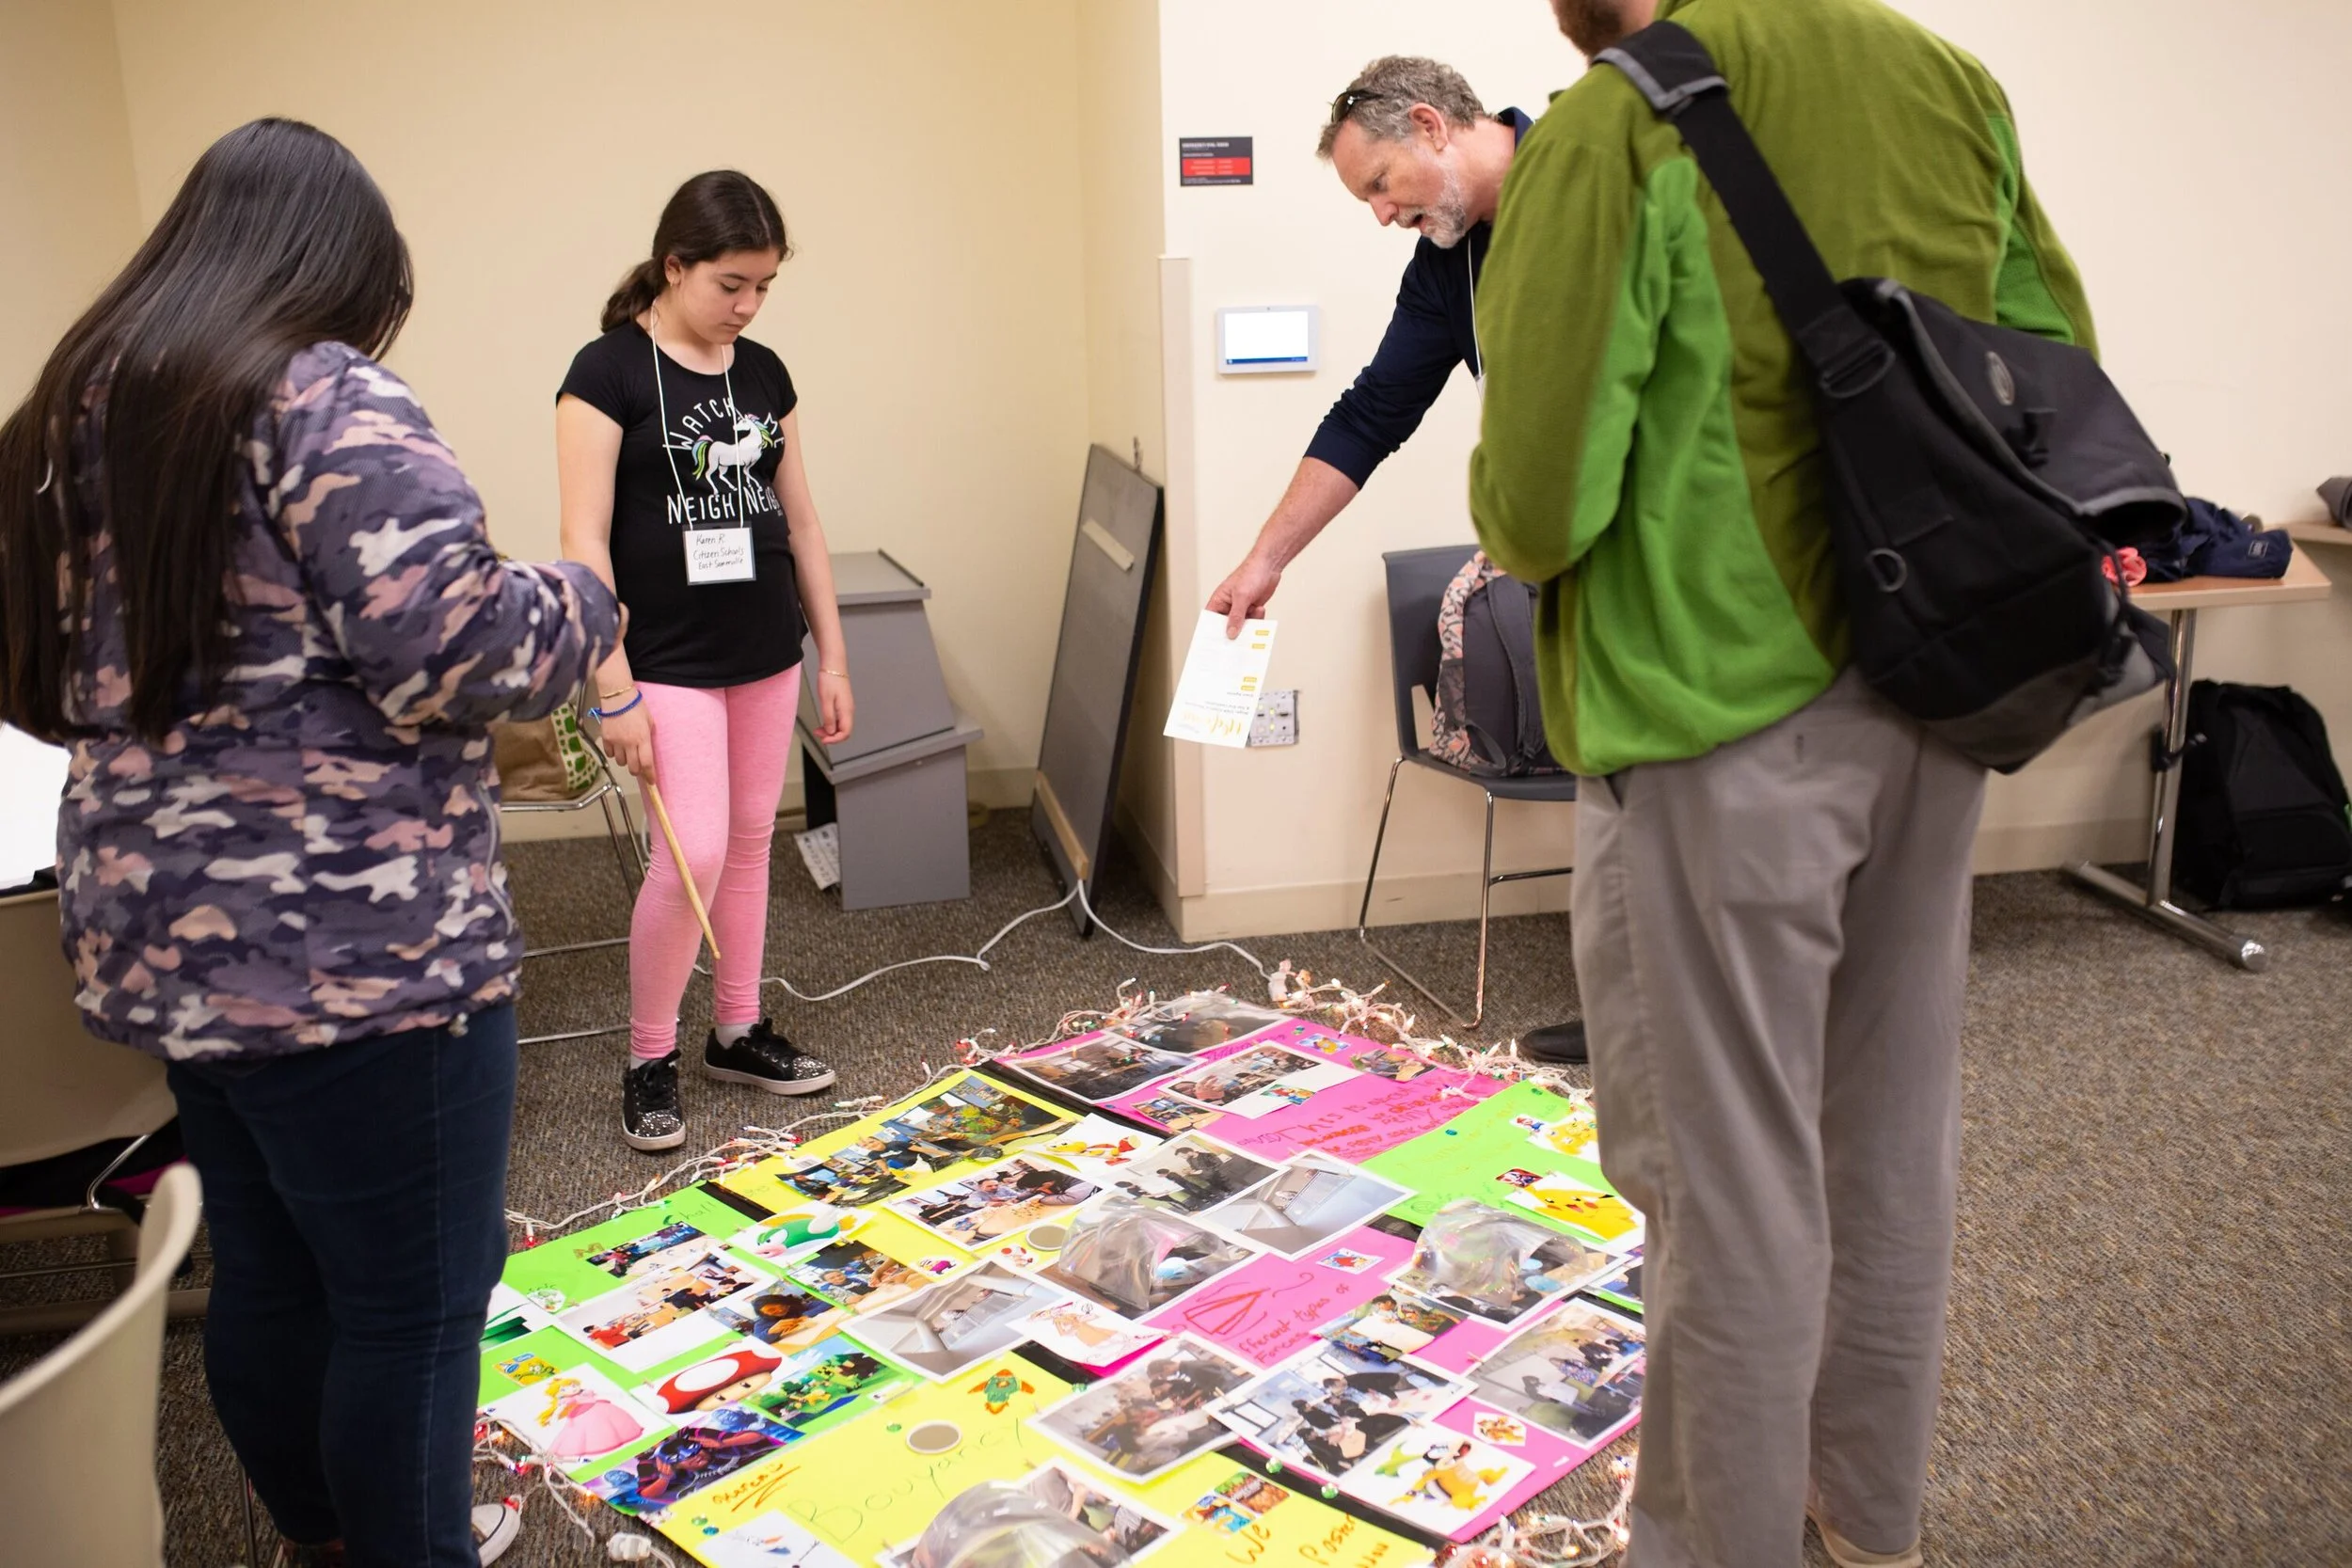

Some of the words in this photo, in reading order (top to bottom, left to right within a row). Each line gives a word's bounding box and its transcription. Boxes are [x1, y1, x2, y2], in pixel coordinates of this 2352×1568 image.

[662, 397, 736, 451] WATCH
[667, 493, 736, 525] NEIGH
[743, 485, 780, 515] NEIG
[696, 533, 716, 546] Karen
[1294, 1297, 1331, 1323] types
